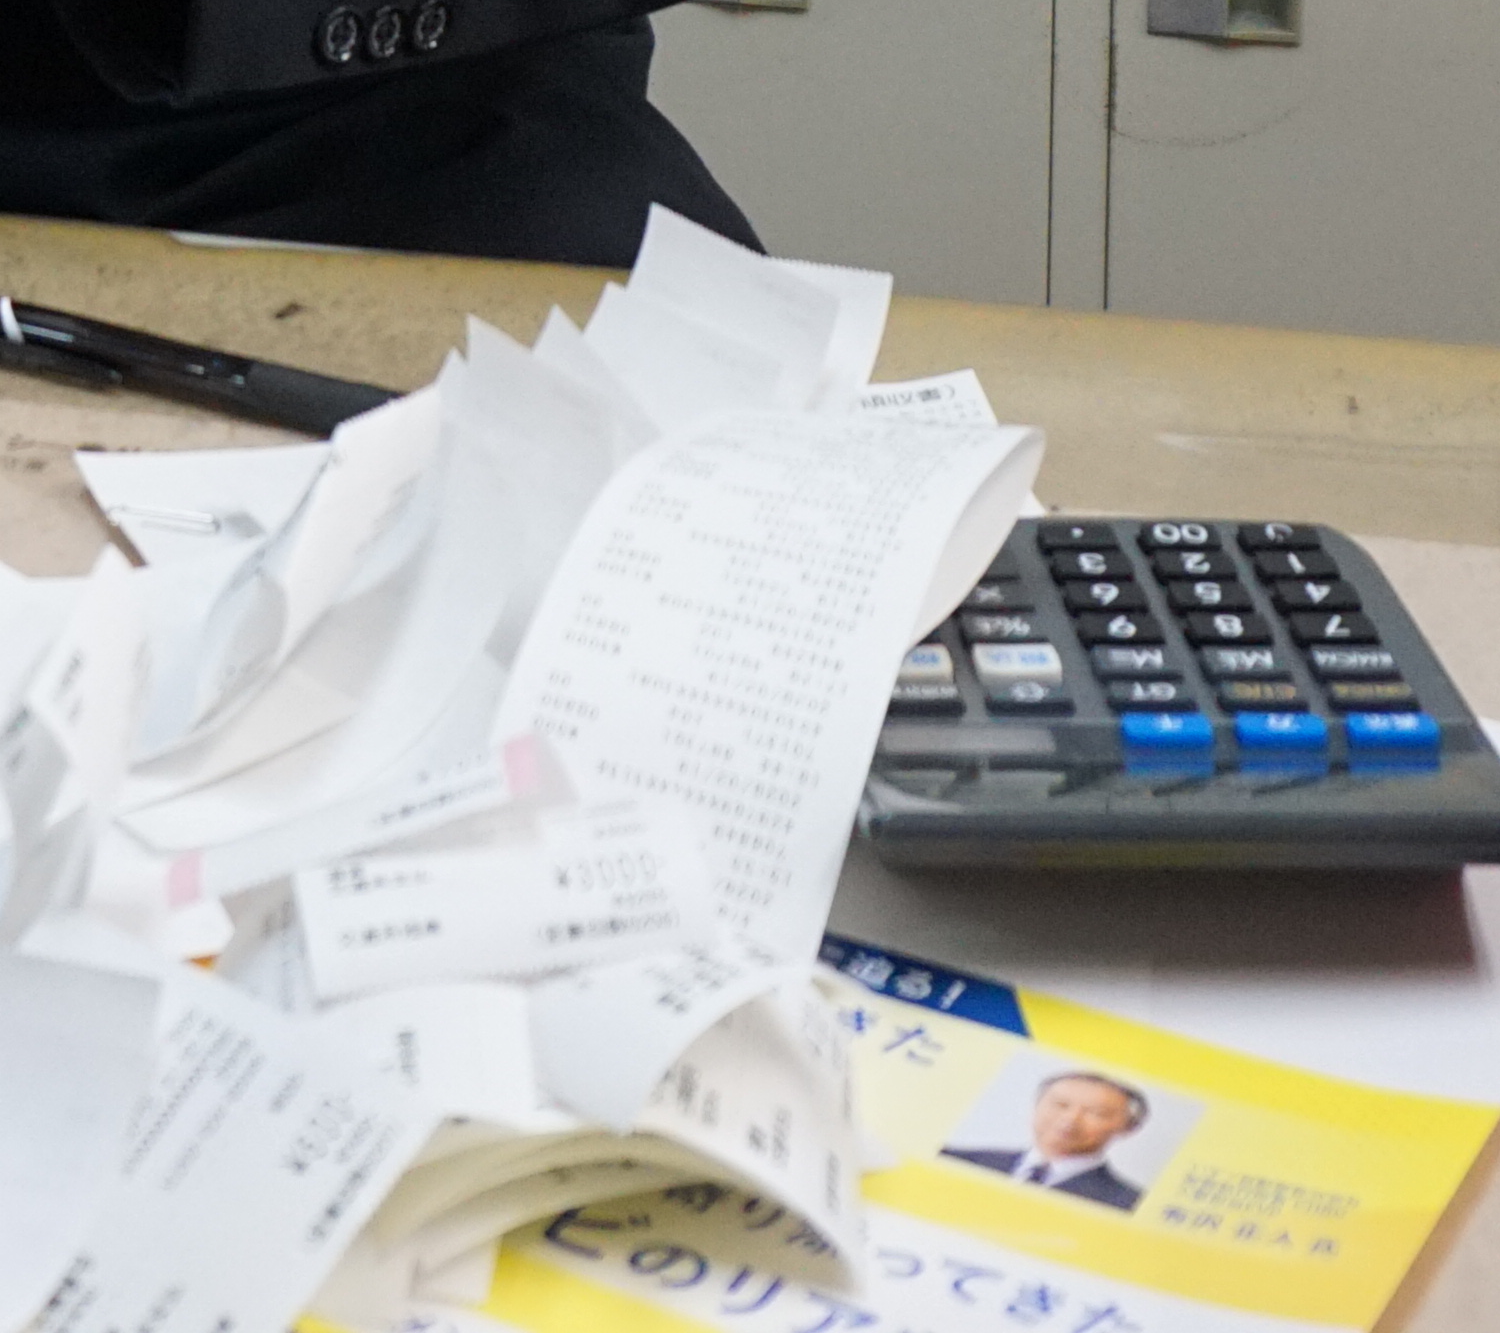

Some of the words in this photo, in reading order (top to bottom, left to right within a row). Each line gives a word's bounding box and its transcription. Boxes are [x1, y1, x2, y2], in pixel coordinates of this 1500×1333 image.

[1152, 523, 1208, 544] 00
[1078, 553, 1107, 574] 3
[1181, 553, 1212, 574] 2
[1286, 552, 1307, 574] 1
[1091, 583, 1120, 605] 6
[1195, 582, 1223, 604] 5
[1302, 582, 1332, 603] 4
[1108, 615, 1138, 637] 9
[1213, 614, 1244, 637] 8
[1323, 614, 1351, 636] 7
